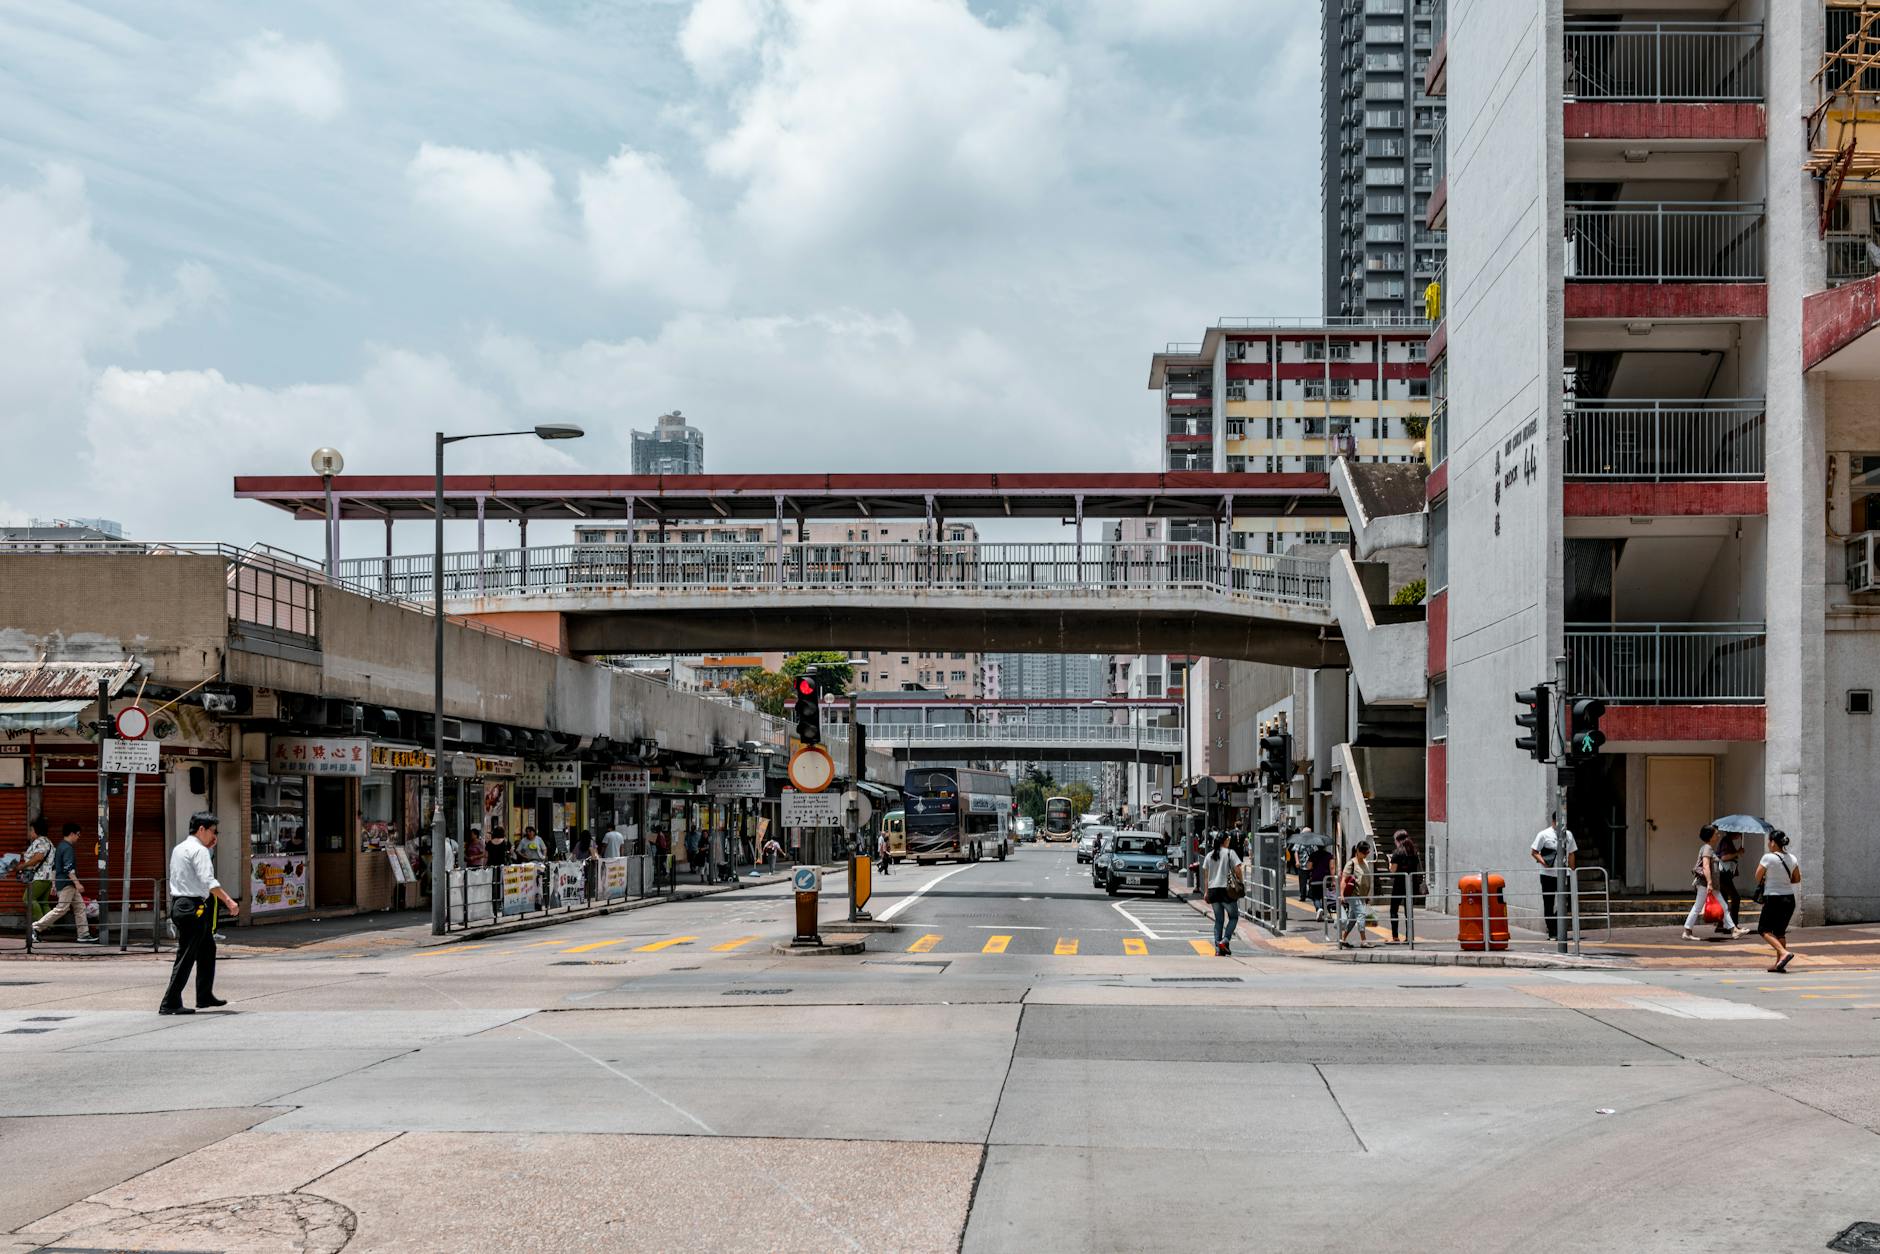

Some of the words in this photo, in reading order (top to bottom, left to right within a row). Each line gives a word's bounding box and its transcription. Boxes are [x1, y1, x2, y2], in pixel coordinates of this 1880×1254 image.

[1523, 418, 1537, 441] HOUSE
[1504, 465, 1518, 488] BLOCK
[1523, 444, 1537, 486] 44
[146, 763, 157, 772] 12
[827, 816, 839, 825] 12
